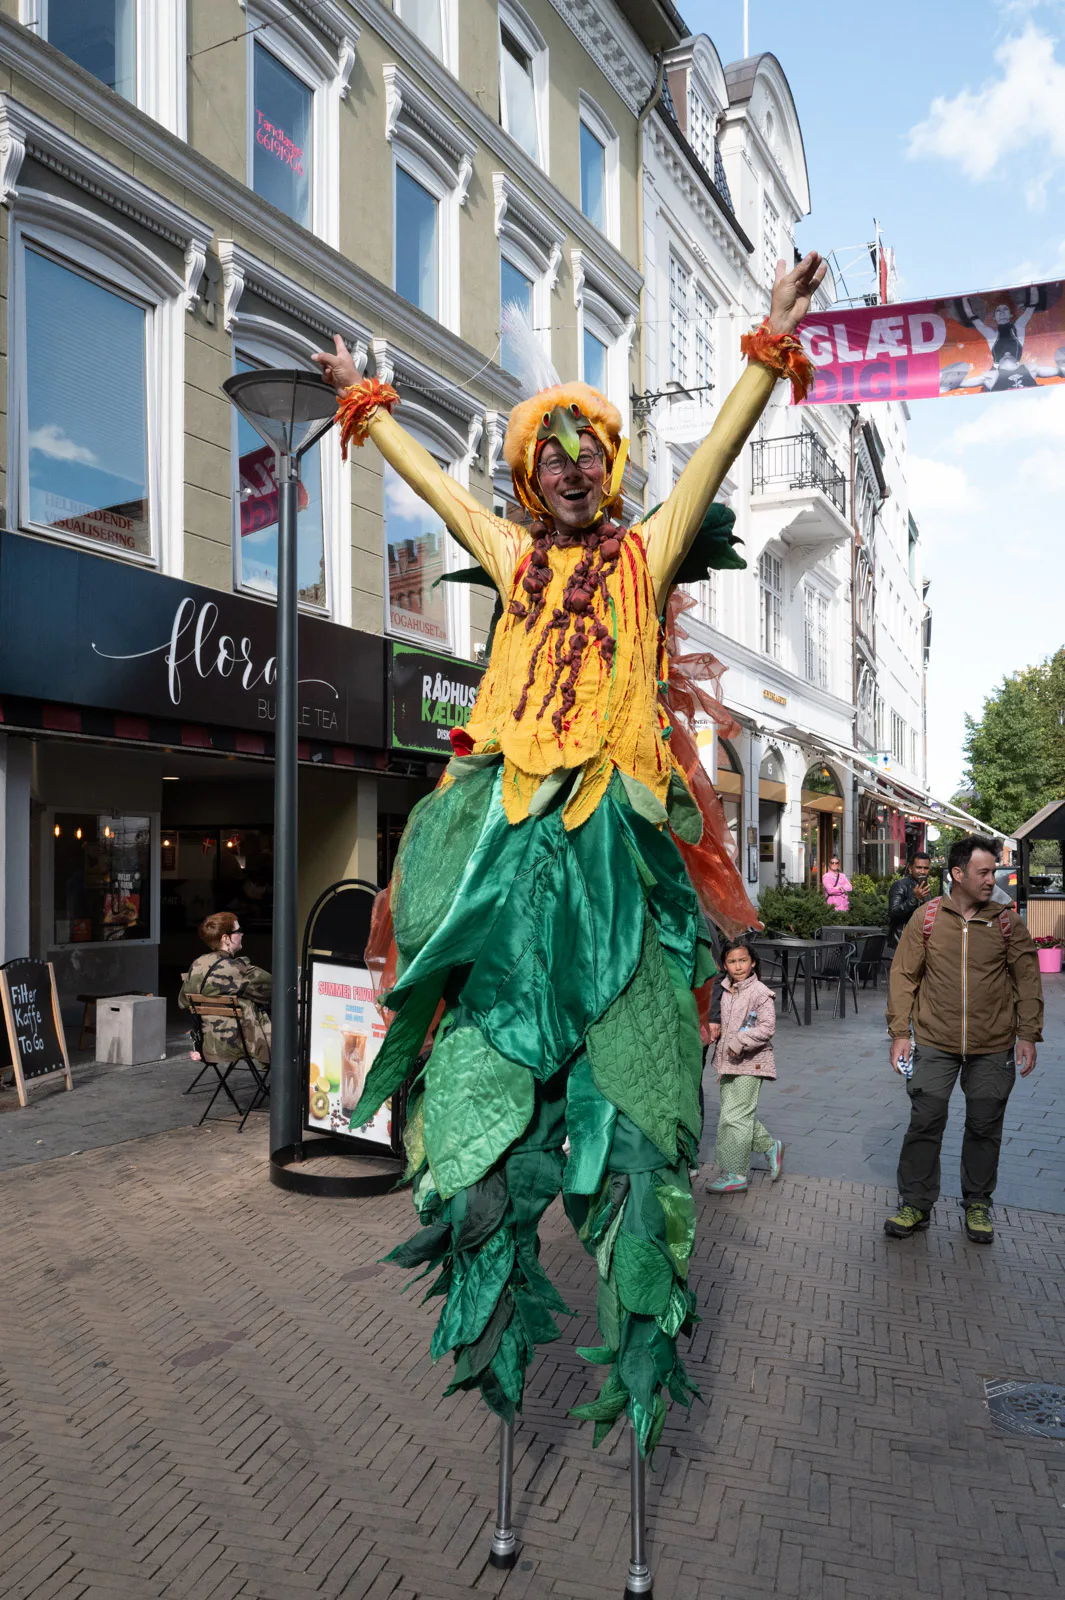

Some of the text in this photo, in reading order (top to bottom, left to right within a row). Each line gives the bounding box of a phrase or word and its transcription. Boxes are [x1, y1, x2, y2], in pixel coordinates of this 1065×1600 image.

[800, 313, 947, 366] GLÆD
[803, 359, 909, 403] DIG!
[44, 511, 135, 548] VISUALISERING
[422, 672, 476, 708] RÅDHUS
[314, 708, 338, 731] TEA
[767, 762, 773, 775] 15
[11, 983, 37, 1004] Filter
[318, 981, 351, 999] SUMMER
[14, 1004, 42, 1033] Kaffe
[19, 1033, 44, 1054] To Go
